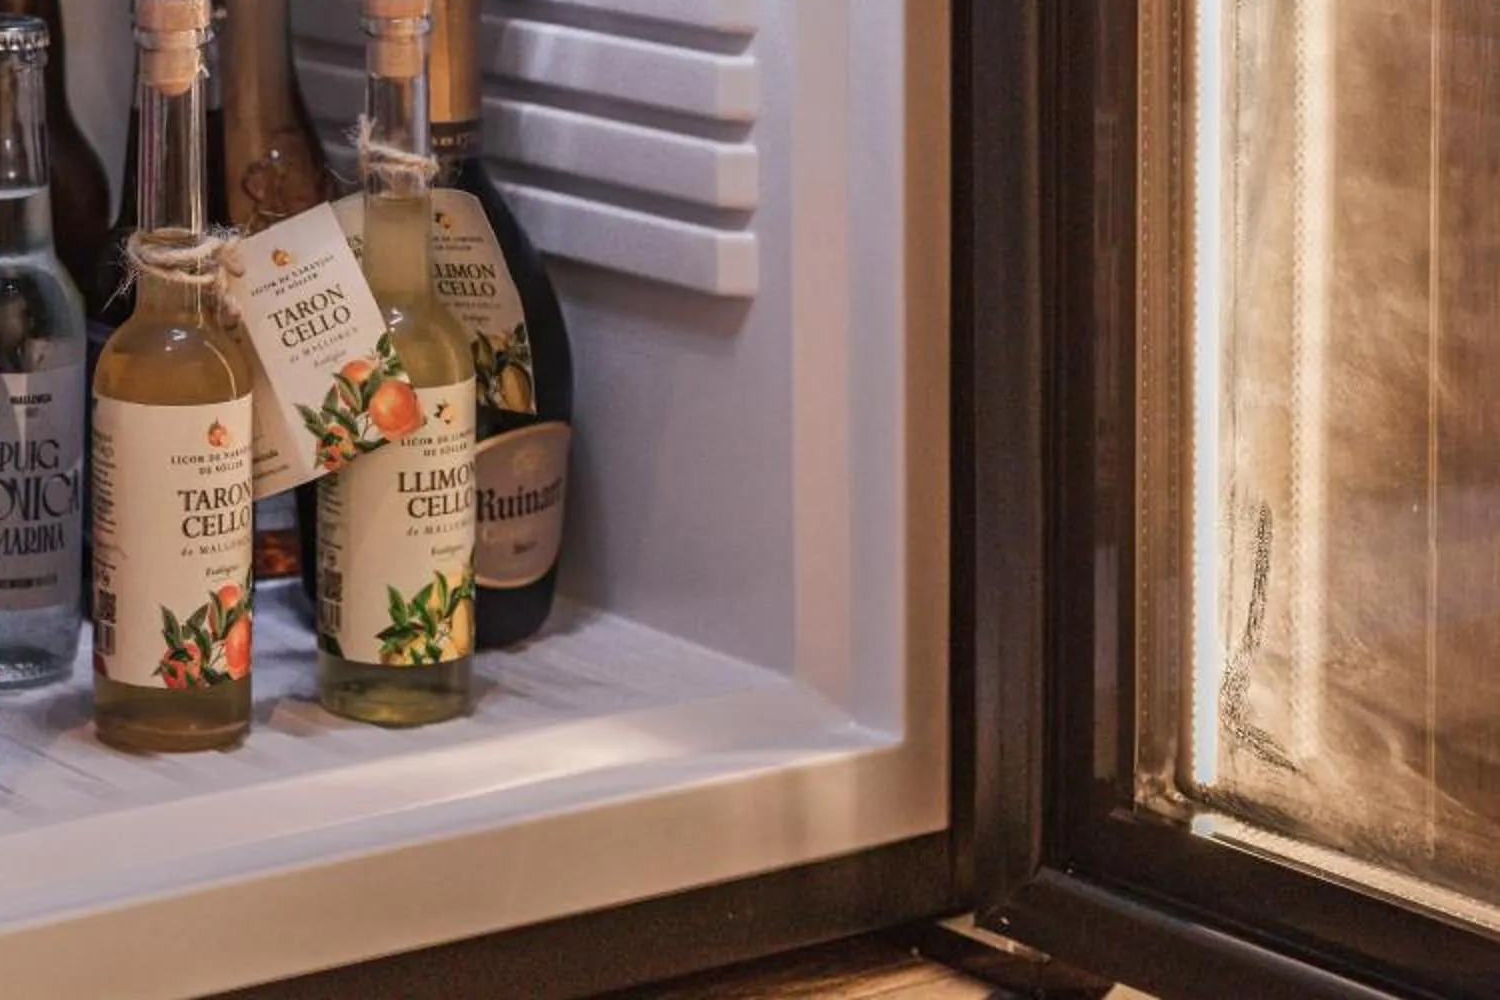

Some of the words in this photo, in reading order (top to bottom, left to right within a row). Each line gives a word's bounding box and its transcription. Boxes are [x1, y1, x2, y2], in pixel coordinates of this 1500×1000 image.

[267, 283, 345, 330] TARON
[437, 280, 498, 297] CELLO
[281, 305, 351, 348] CELLO
